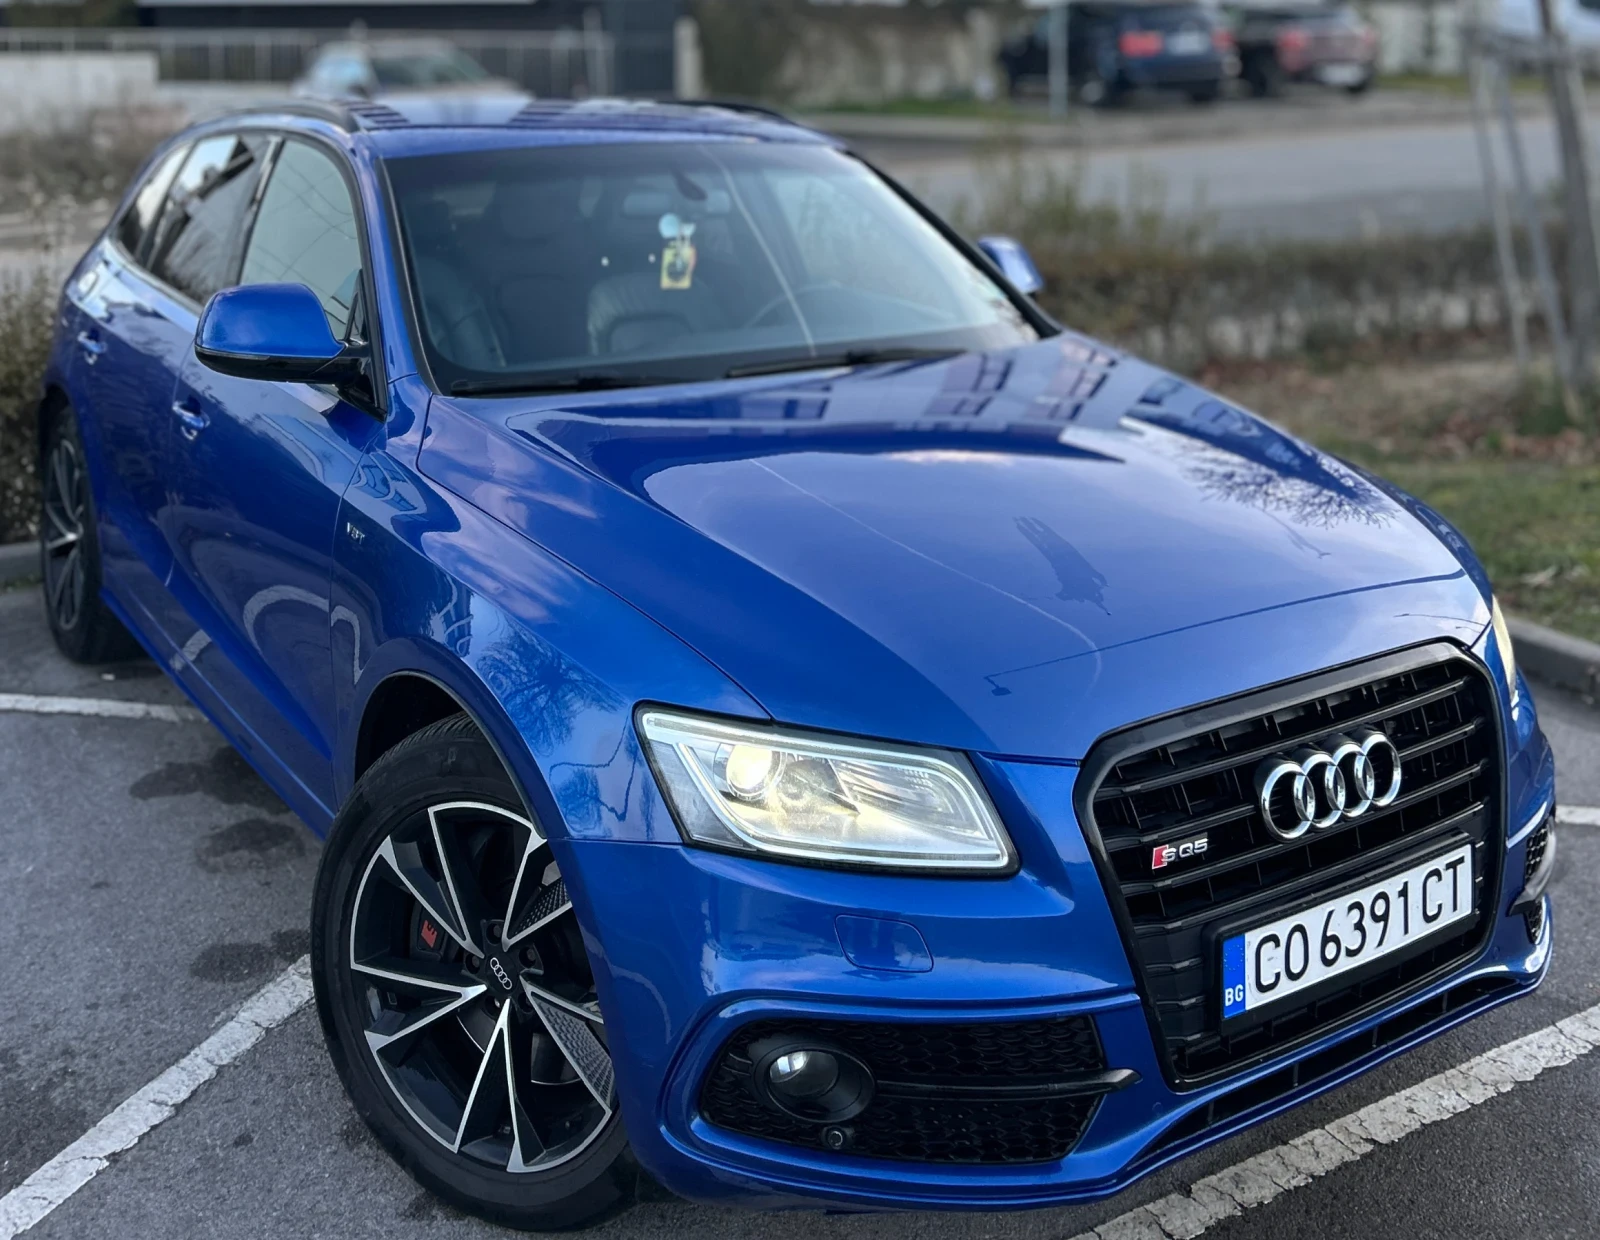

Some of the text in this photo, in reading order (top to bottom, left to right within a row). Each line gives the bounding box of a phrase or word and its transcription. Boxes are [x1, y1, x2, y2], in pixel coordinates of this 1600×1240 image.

[1160, 838, 1208, 861] SQ5
[1320, 880, 1409, 967] 6391
[1422, 856, 1465, 923] CT
[1225, 984, 1244, 1006] BG
